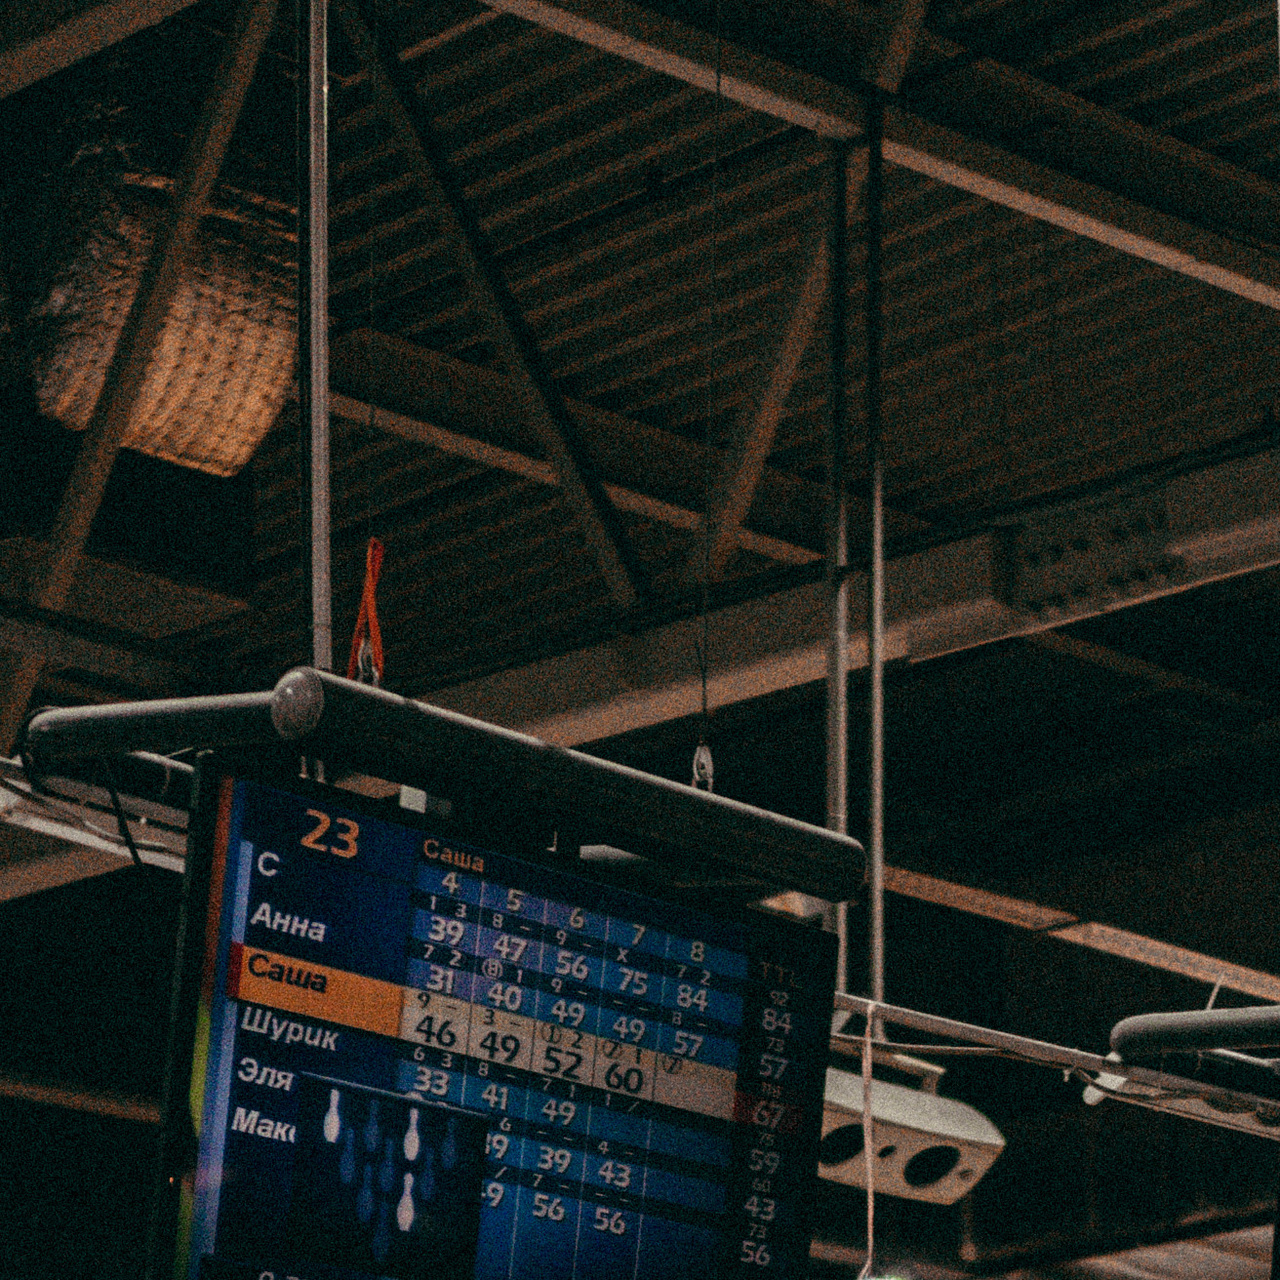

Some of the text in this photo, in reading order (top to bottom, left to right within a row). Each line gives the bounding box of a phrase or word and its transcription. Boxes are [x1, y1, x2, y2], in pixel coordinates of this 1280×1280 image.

[301, 809, 360, 859] 23
[422, 838, 486, 873] Саша
[256, 851, 281, 876] С
[250, 902, 327, 942] Анна
[442, 871, 459, 894] 4
[507, 888, 525, 912] 5
[569, 907, 585, 929] 6
[632, 923, 647, 945] 7
[690, 941, 706, 963] 8
[423, 943, 435, 959] 7
[448, 950, 463, 967] 2
[551, 978, 563, 995] 9
[456, 903, 468, 918] 3
[491, 913, 504, 929] 8
[555, 931, 568, 948] 9
[700, 970, 712, 986] 2
[248, 954, 328, 993] Саша
[429, 915, 793, 1034] 39 47 56 75 84 84
[240, 1006, 339, 1053] Шурик
[417, 993, 430, 1009] 9
[485, 1009, 495, 1026] 3
[426, 965, 789, 1079] 31 40 49 49 57 57
[237, 1057, 296, 1092] Эля
[413, 1048, 426, 1062] 6
[441, 1053, 454, 1069] 3
[415, 1017, 785, 1130] 46 49 52 60 67
[413, 1064, 781, 1175] 33 41 49 59
[499, 1116, 512, 1133] 6
[536, 1144, 572, 1174] 39
[598, 1160, 632, 1189] 43
[744, 1195, 776, 1222] 43
[481, 1181, 771, 1266] 9 56 56 56
